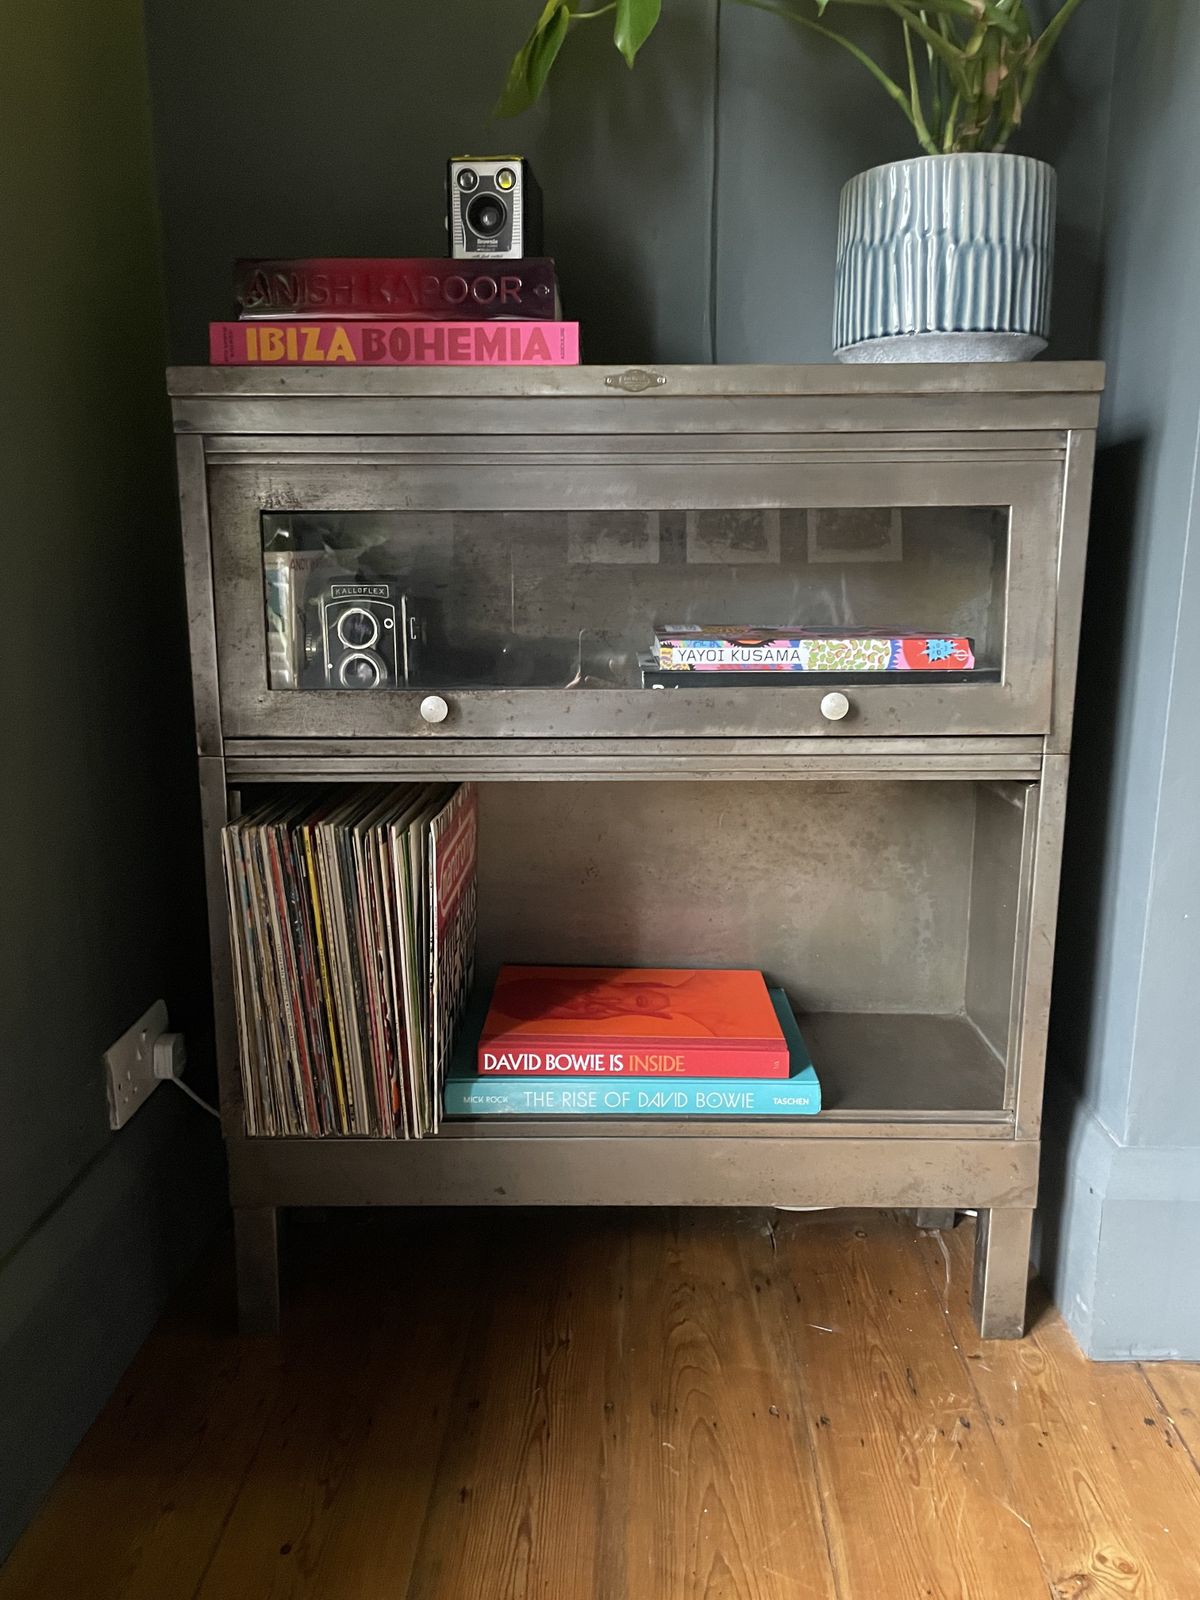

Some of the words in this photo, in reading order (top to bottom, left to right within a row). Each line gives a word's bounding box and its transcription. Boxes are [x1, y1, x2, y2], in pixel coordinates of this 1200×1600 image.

[246, 269, 355, 307] ANISH
[374, 274, 523, 305] KAPOOR
[246, 326, 356, 361] IBIZA
[361, 327, 552, 361] BOHEMIA
[335, 587, 385, 595] KALLOFLEX
[677, 649, 725, 662] YAYOI
[730, 649, 800, 662] KUSAMA
[484, 1053, 541, 1072] DAVID
[545, 1054, 605, 1072] BOWIE
[609, 1054, 624, 1072] IS
[629, 1055, 686, 1072] INSIDE
[463, 1096, 484, 1104] MICK
[486, 1095, 508, 1104] ROCK
[523, 1091, 554, 1107] THE
[561, 1091, 597, 1108] RISE
[604, 1091, 630, 1108] OF
[638, 1091, 688, 1109] DAVID
[696, 1091, 754, 1109] BOWIE
[773, 1097, 810, 1105] TASCHEN
